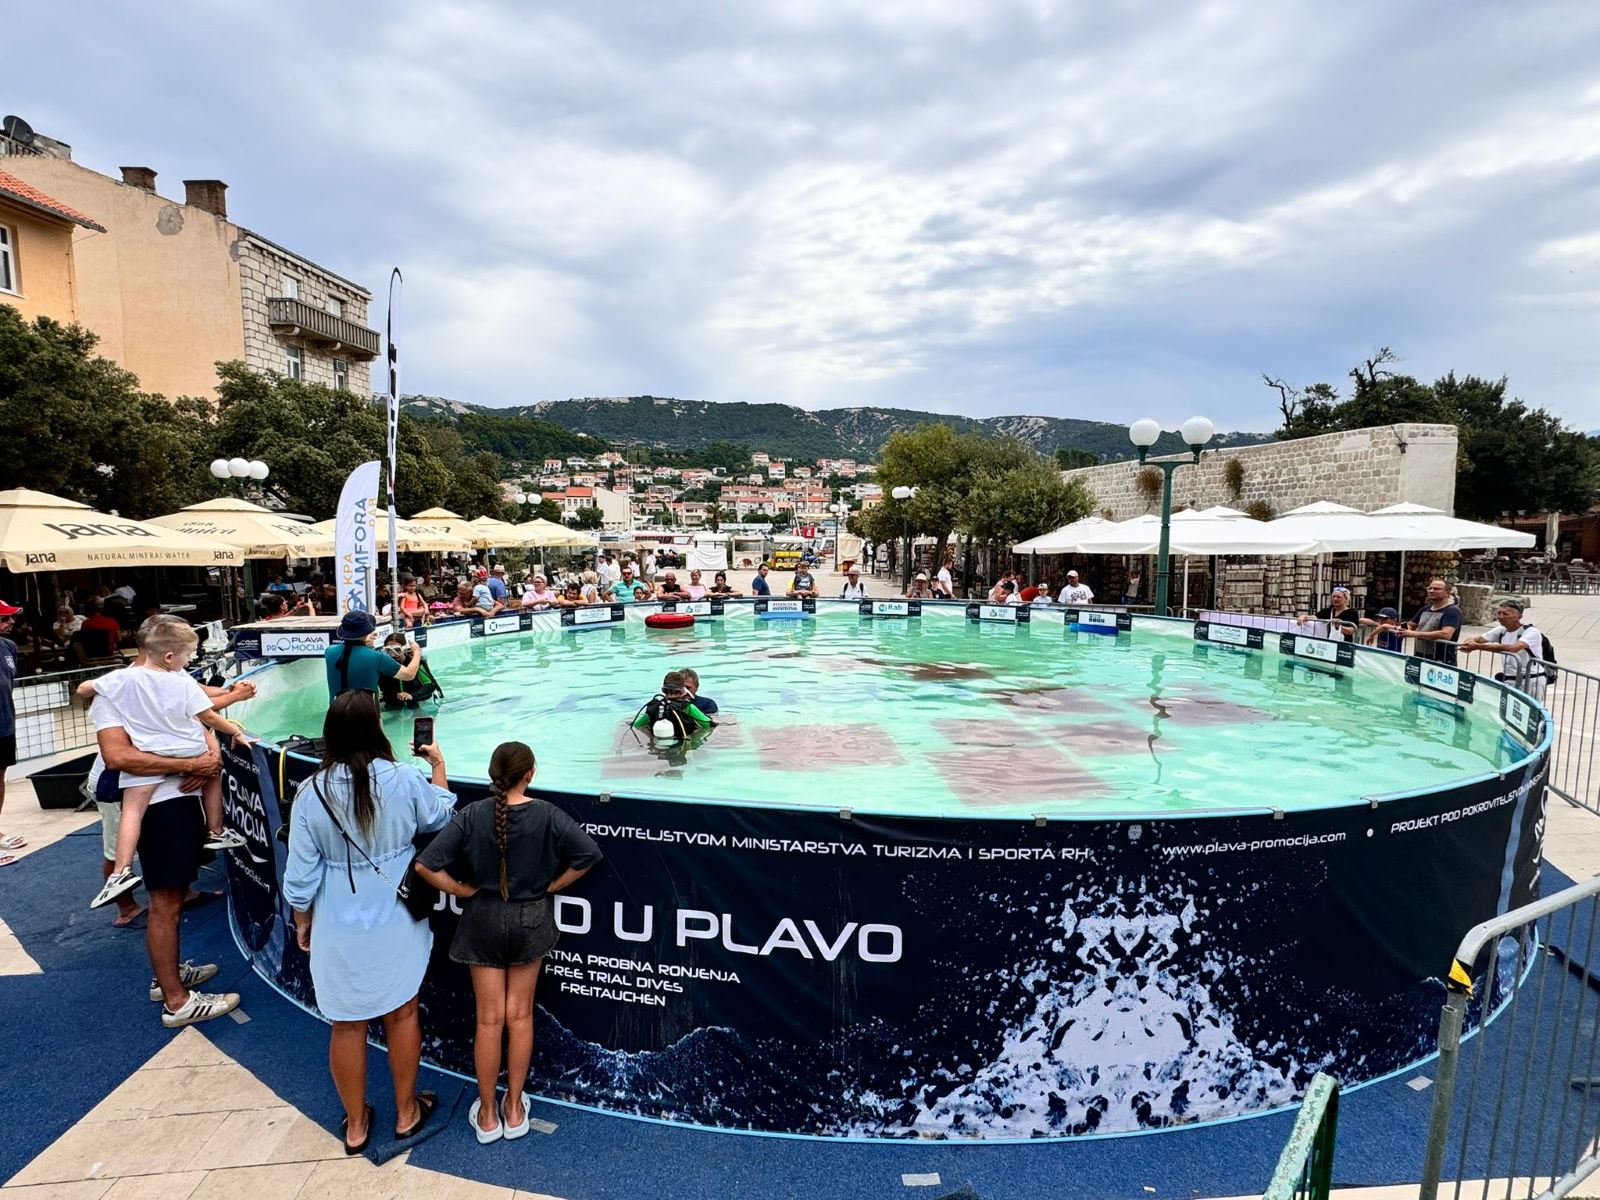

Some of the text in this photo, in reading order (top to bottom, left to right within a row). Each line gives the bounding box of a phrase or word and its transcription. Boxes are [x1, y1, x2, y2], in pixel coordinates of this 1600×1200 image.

[43, 523, 162, 540] Jana
[25, 552, 57, 566] Jana
[87, 552, 127, 561] NATURAL
[166, 552, 191, 560] WATER
[213, 548, 235, 561] Jana
[1437, 671, 1454, 685] Rab
[1391, 815, 1440, 834] PROJEKT
[1441, 809, 1461, 823] POD
[731, 836, 867, 857] MINISTARSTVA
[872, 844, 962, 860] TURIZMA
[968, 849, 974, 860] I
[978, 848, 1057, 861] SPORTA
[1061, 847, 1090, 861] RH
[1162, 830, 1347, 856] www.plava-promocija.com
[613, 901, 654, 943] U
[676, 908, 903, 963] PLAVO
[545, 964, 684, 993] FREE TRIAL DIVES
[587, 954, 655, 974] PROBNA
[658, 964, 741, 984] RONJENJA
[560, 982, 667, 1007] FREITAUCHEN
